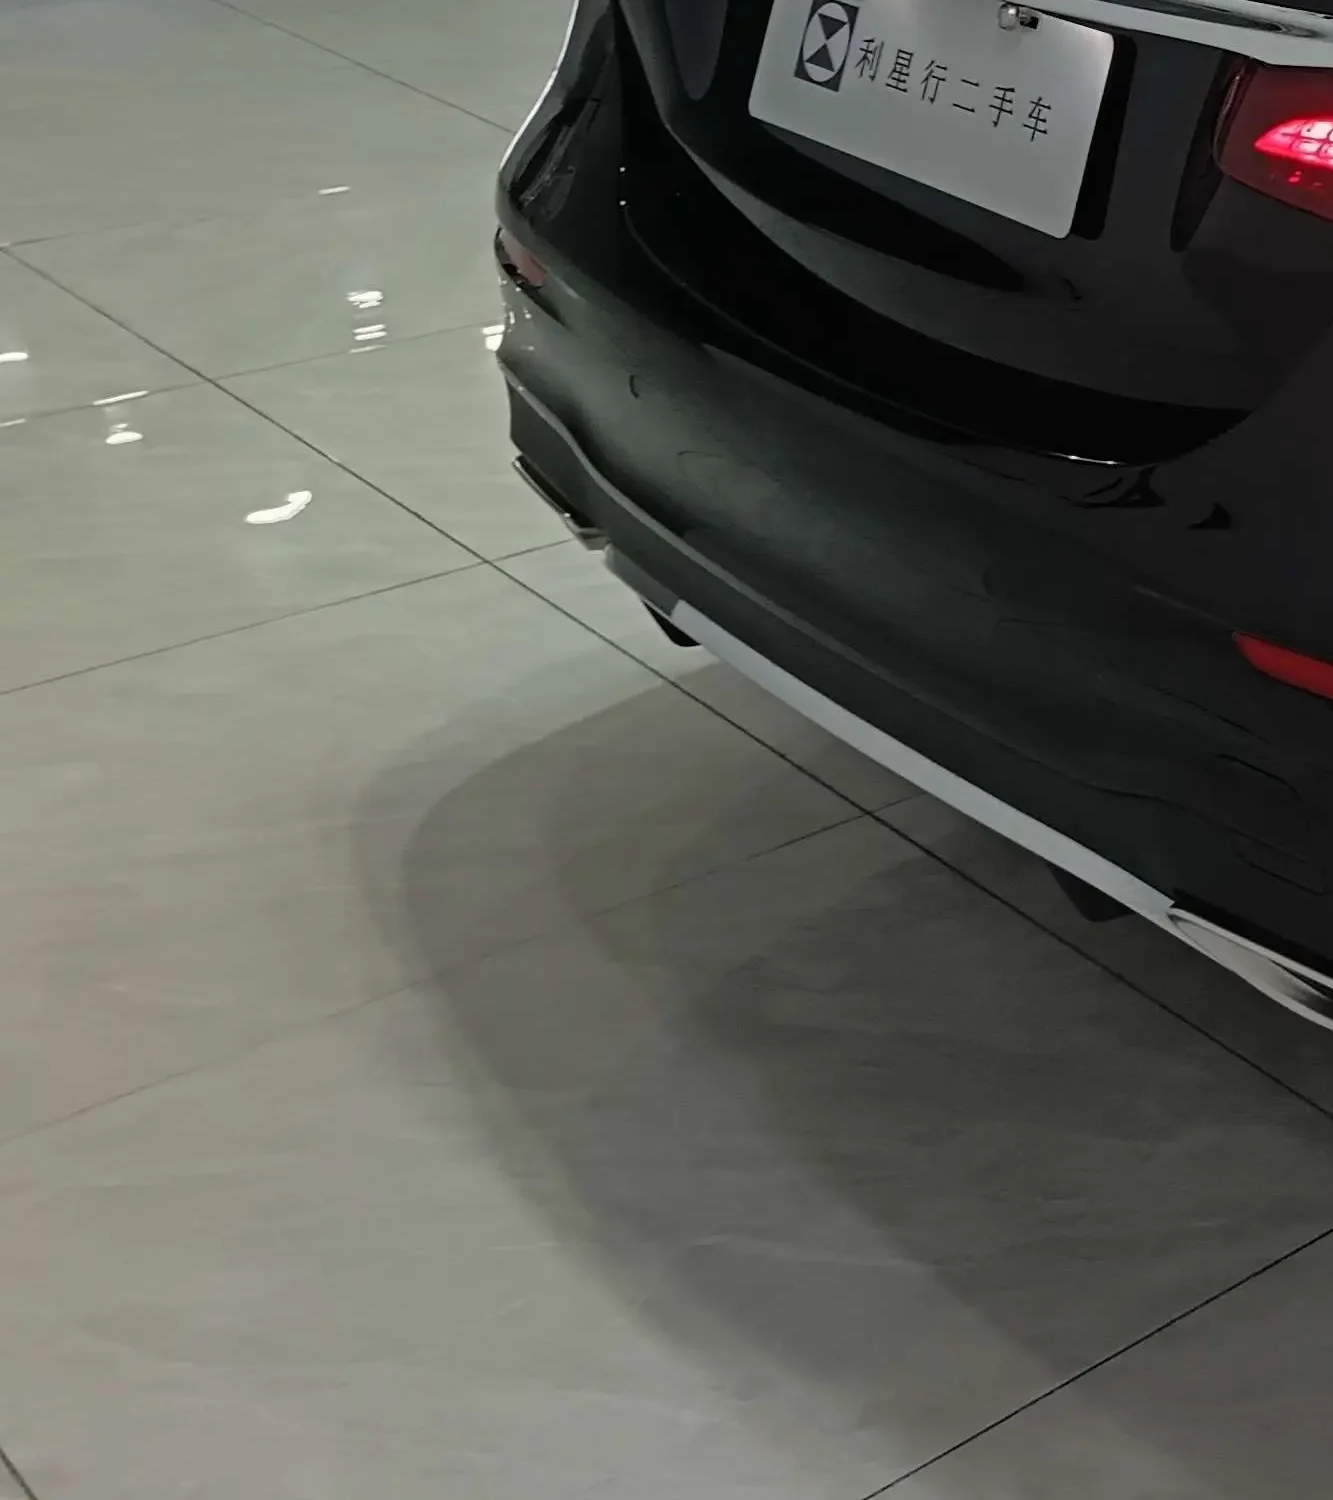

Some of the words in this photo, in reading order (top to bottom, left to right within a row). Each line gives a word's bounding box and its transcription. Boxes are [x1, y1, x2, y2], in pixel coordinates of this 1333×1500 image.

[855, 37, 1052, 142] 利星行二手车
